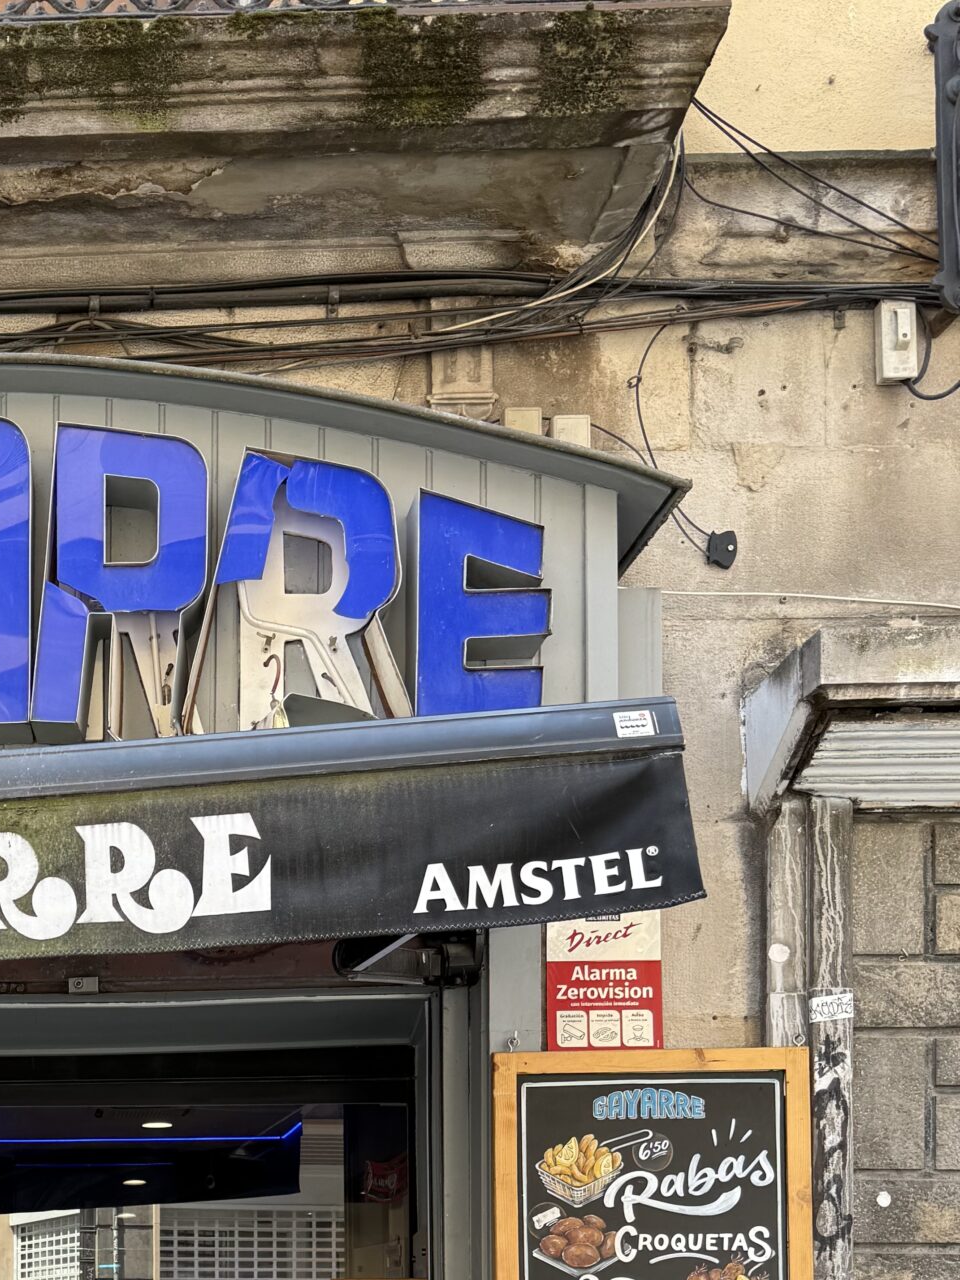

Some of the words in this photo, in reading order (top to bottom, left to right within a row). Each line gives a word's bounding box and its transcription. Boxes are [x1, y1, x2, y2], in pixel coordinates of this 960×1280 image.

[566, 922, 643, 952] Direct
[571, 965, 637, 981] Alarma
[556, 982, 653, 999] Zerovision
[593, 1088, 705, 1120] GAYARRE
[604, 1150, 775, 1222] Rabas
[615, 1225, 772, 1262] CROQUETAS
